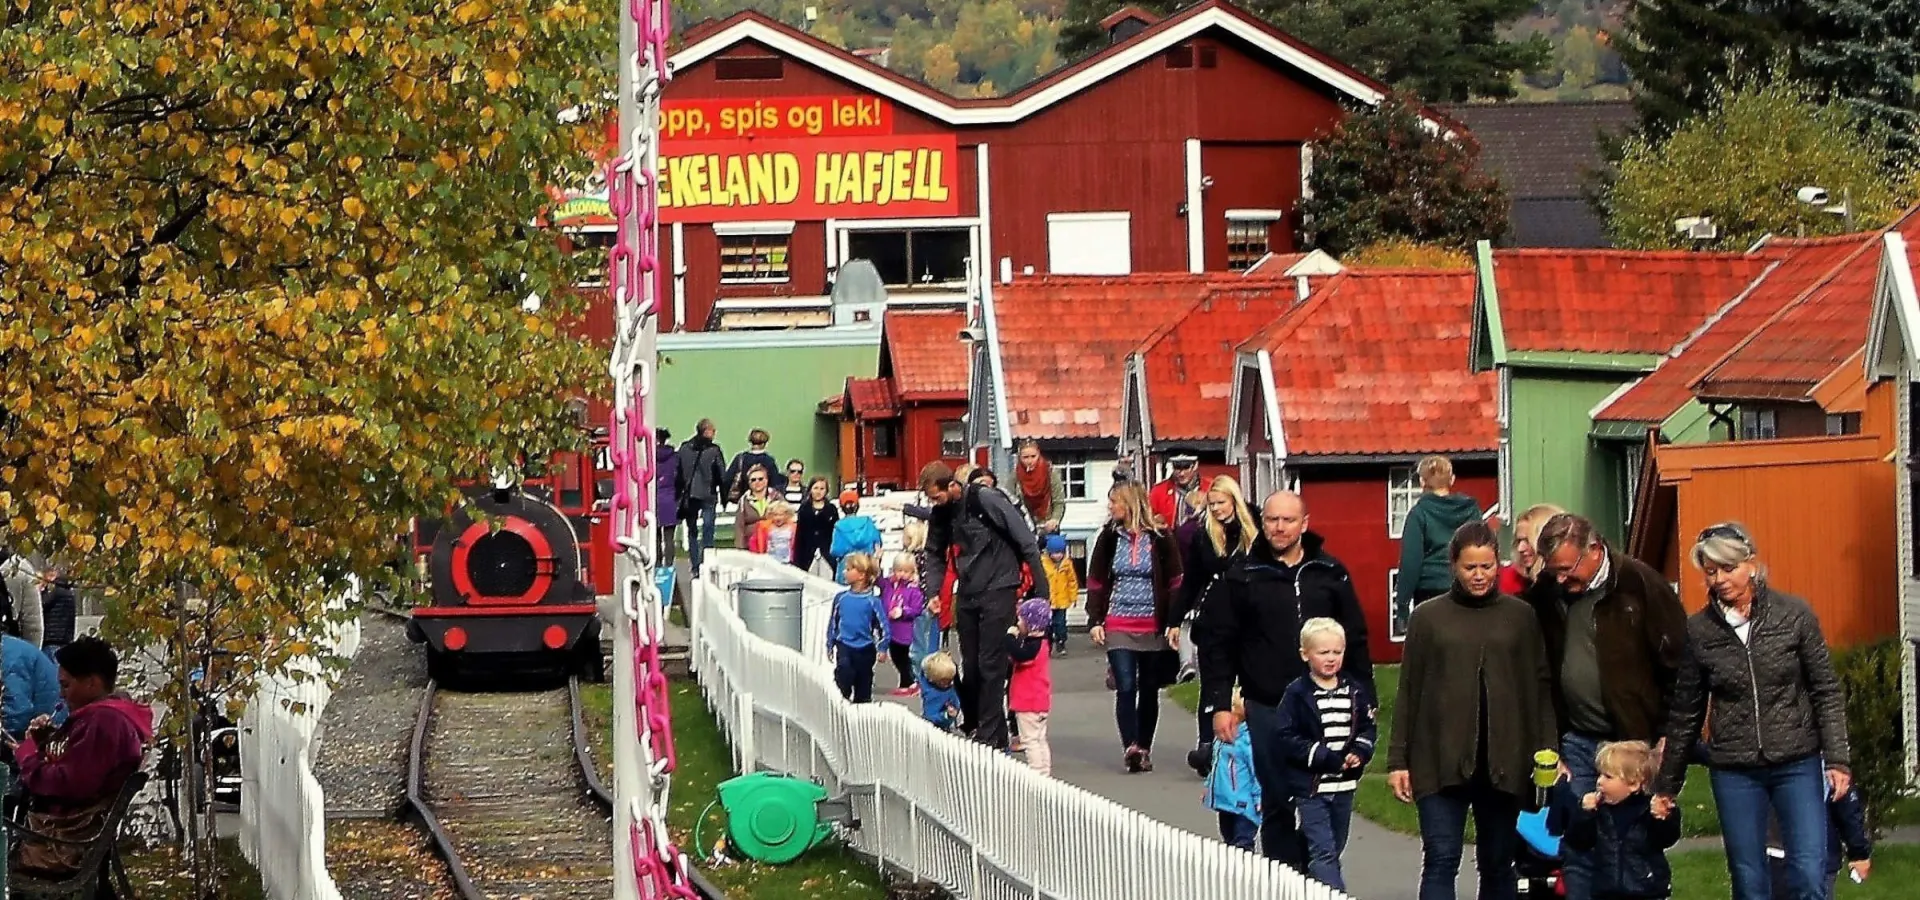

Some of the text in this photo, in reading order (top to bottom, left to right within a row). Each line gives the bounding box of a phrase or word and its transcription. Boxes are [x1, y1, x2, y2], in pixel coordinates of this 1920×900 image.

[658, 98, 881, 137] opp, spis og lek!
[658, 147, 949, 208] EKELAND HAFJELL
